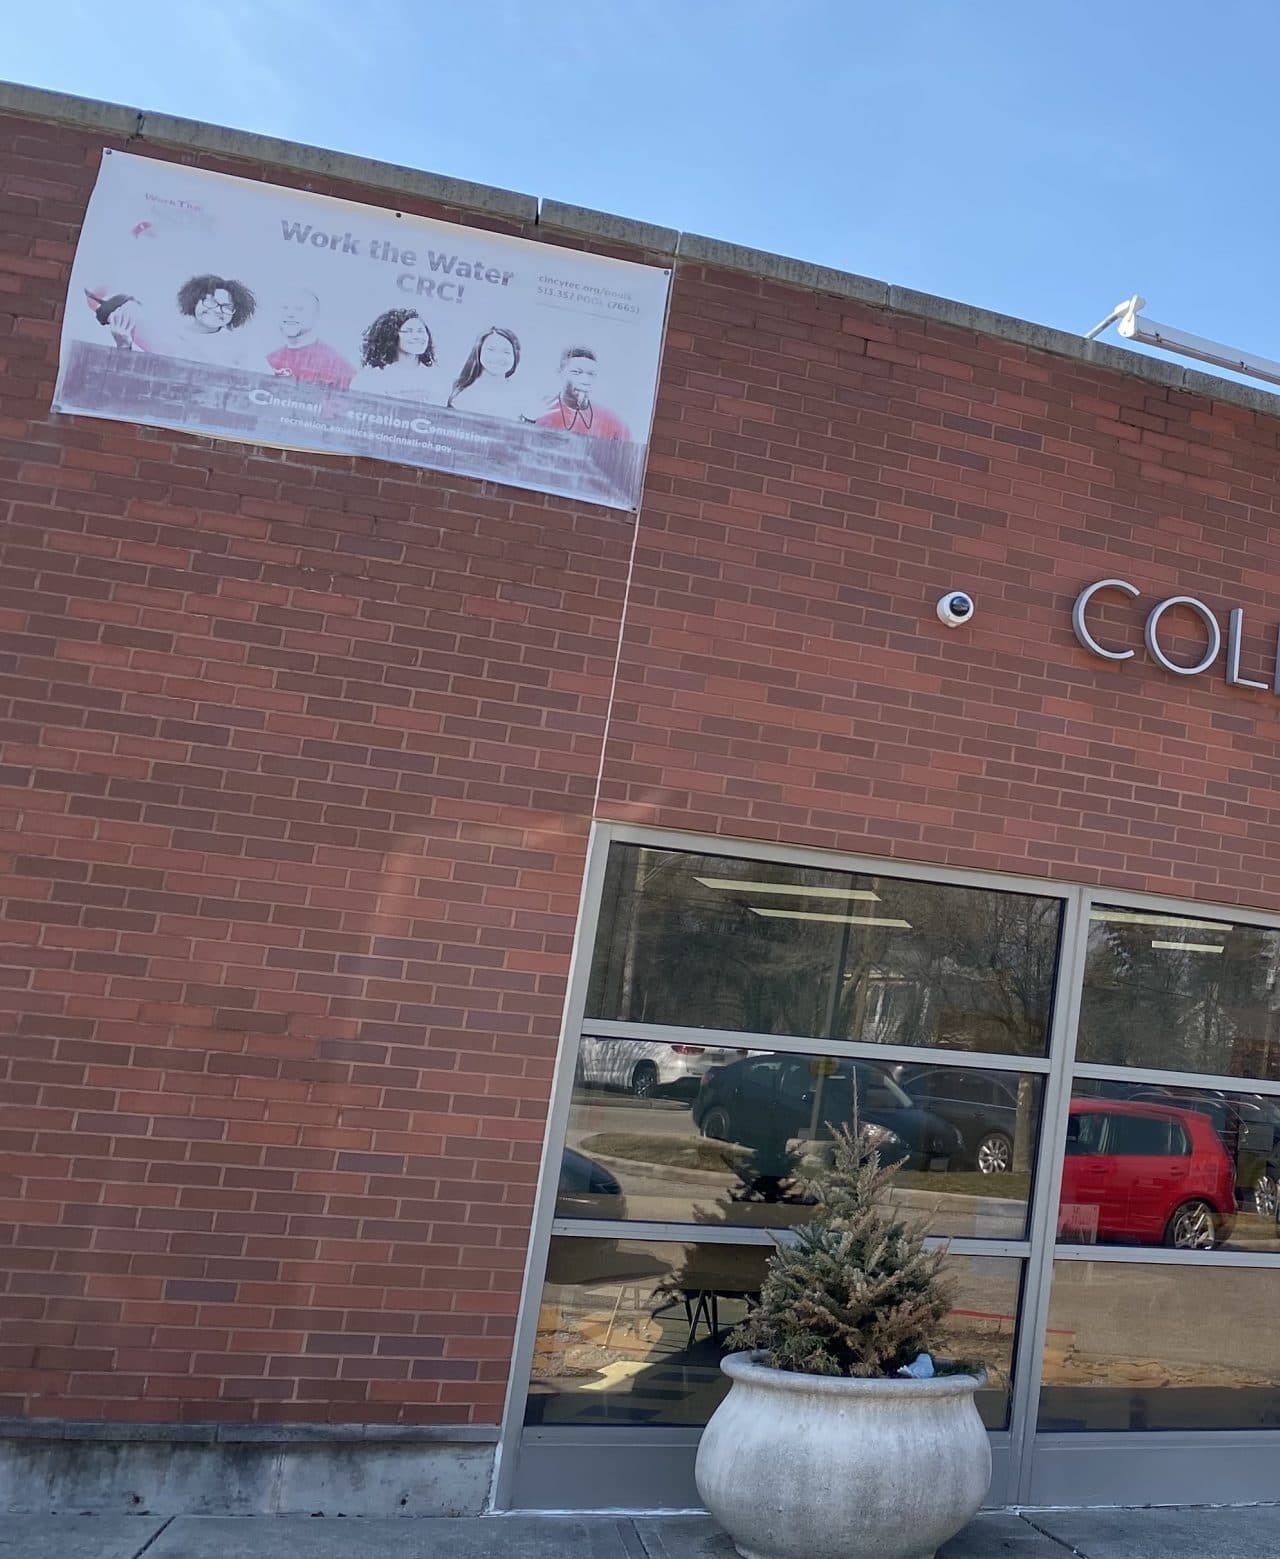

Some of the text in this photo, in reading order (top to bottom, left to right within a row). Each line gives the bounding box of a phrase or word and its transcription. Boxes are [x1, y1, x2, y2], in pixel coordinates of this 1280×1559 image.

[281, 219, 515, 287] Work the Water
[396, 273, 466, 304] CRC!
[248, 389, 322, 414] Cincinnati
